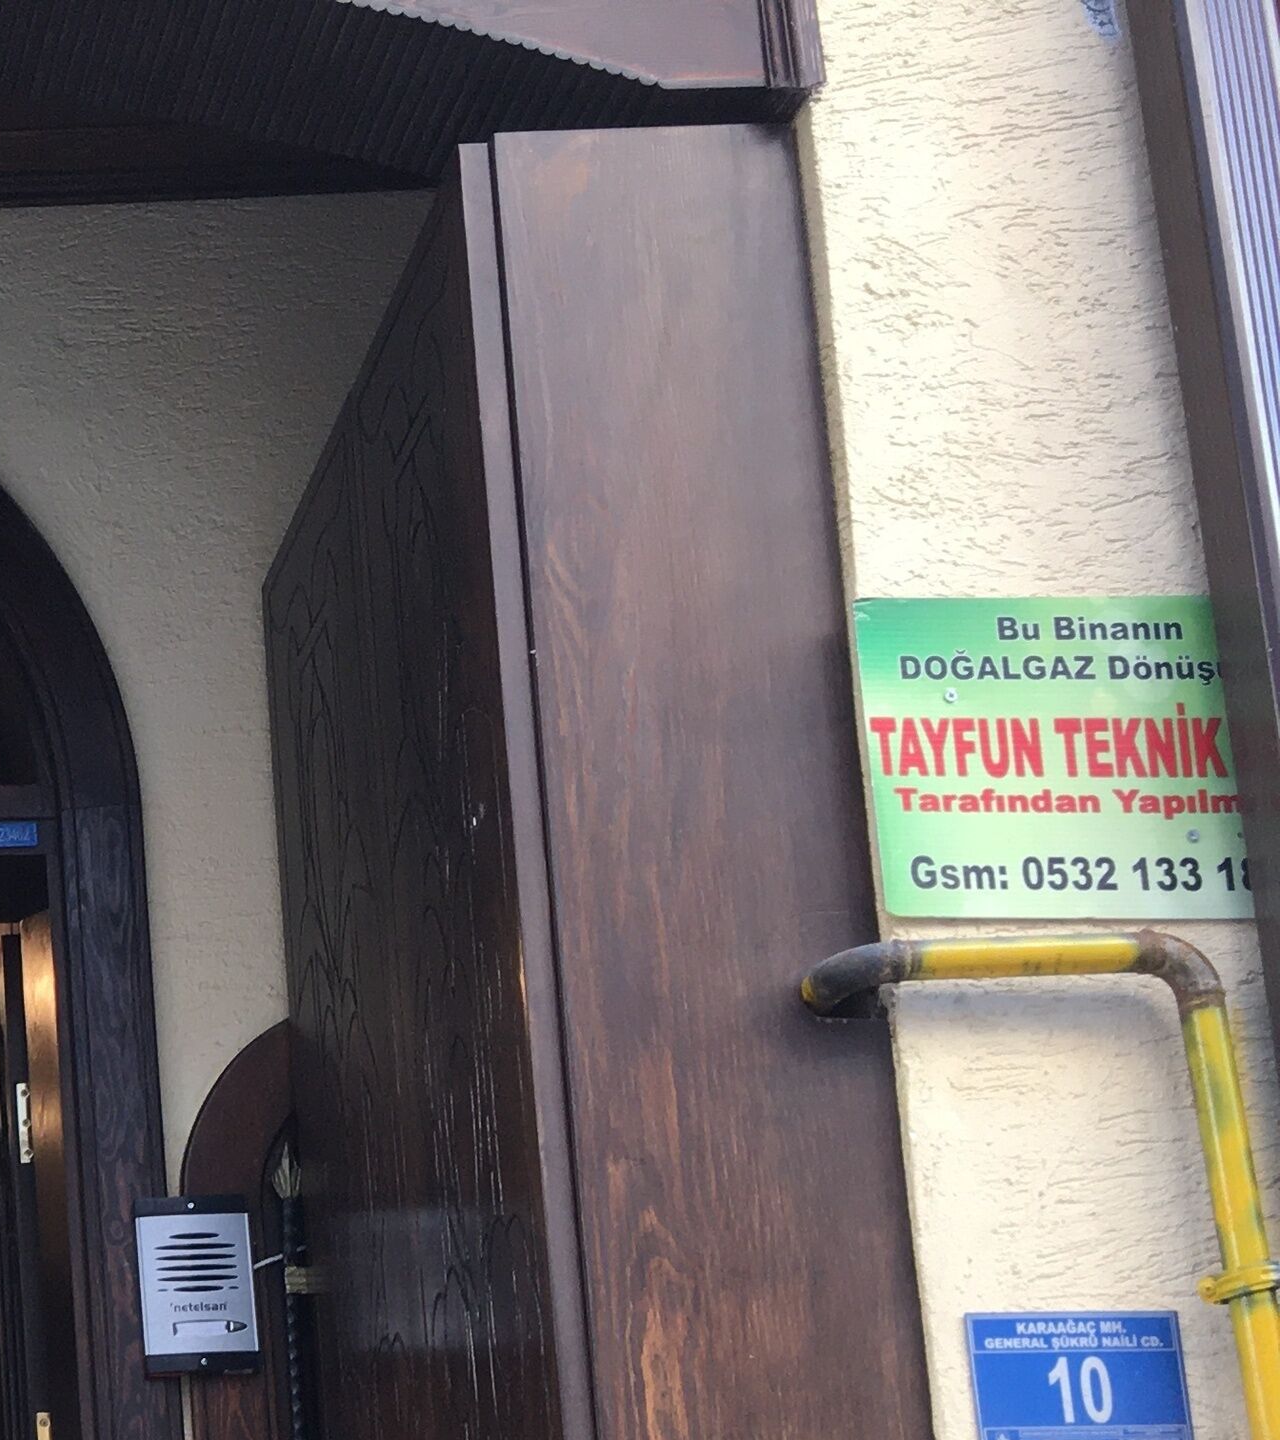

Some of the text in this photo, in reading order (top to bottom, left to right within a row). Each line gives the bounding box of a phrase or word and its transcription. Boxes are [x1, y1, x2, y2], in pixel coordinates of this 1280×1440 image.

[996, 615, 1184, 641] Bu Binanın
[899, 649, 1223, 686] DOĞALGAZ Dönüş
[869, 702, 1229, 779] TAYFUN TEKNİK
[893, 787, 1101, 814] Tarafından
[910, 855, 1009, 891] Gsm:
[1021, 856, 1119, 892] 0532
[1131, 856, 1203, 892] 133
[984, 1336, 1049, 1349] GENERAL
[1051, 1334, 1098, 1350] ŞÜKRÜ
[1140, 1336, 1164, 1348] CD.
[1016, 1319, 1127, 1336] KARAAĞAÇ MH.
[1047, 1356, 1113, 1424] 10
